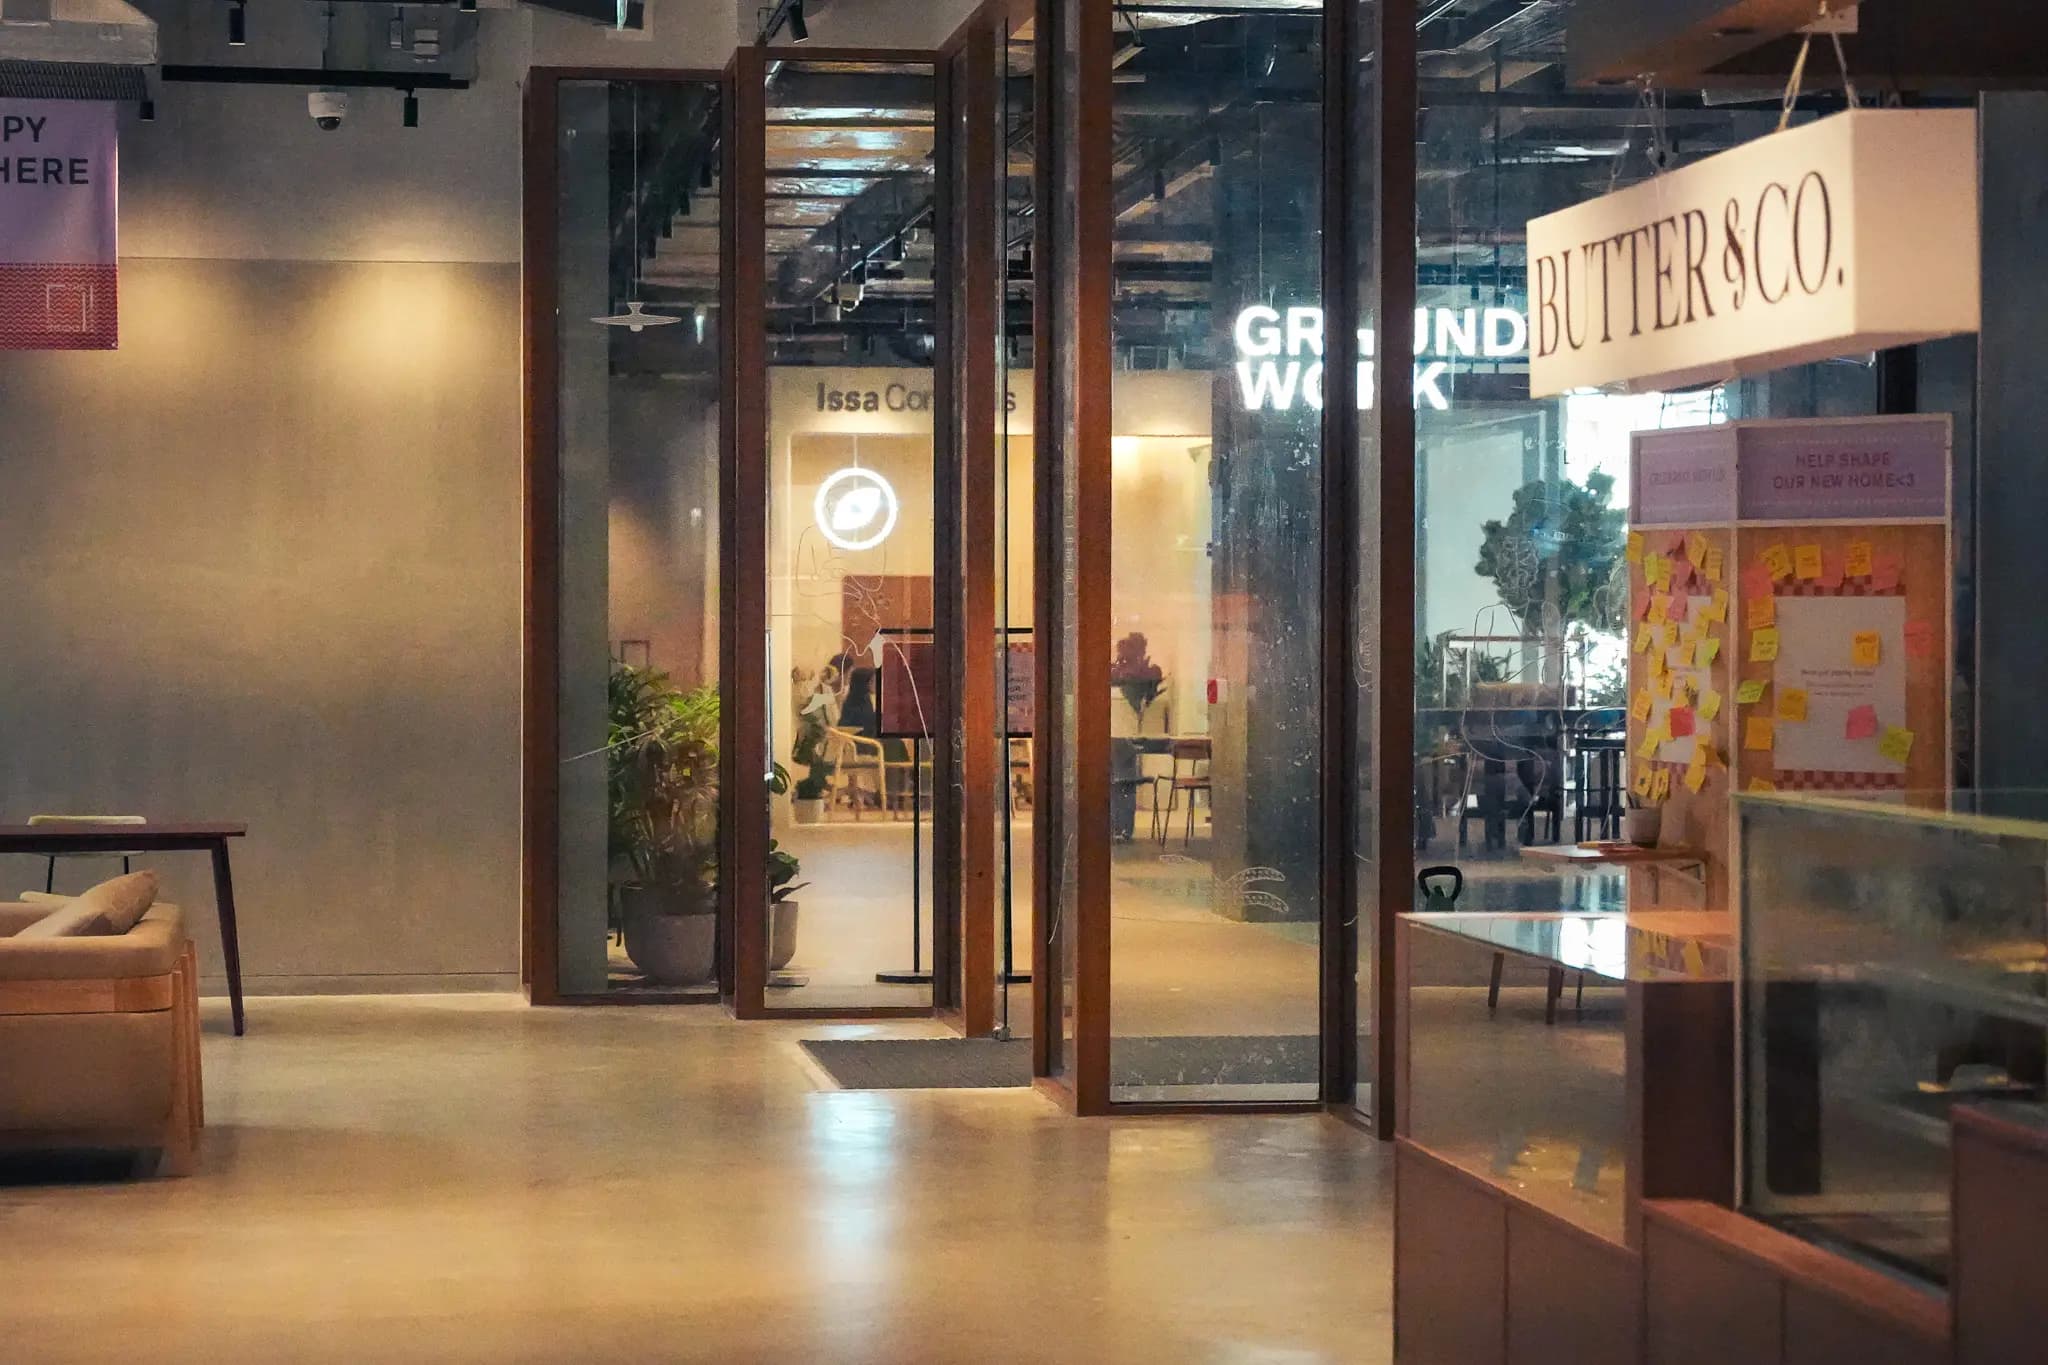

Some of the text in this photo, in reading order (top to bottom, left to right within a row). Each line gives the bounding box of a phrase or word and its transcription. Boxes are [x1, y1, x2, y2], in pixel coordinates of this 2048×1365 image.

[816, 382, 879, 413] Issa
[1795, 451, 1890, 468] HELP SHAPE
[1773, 475, 1805, 489] OUR
[1811, 474, 1842, 488] NEW
